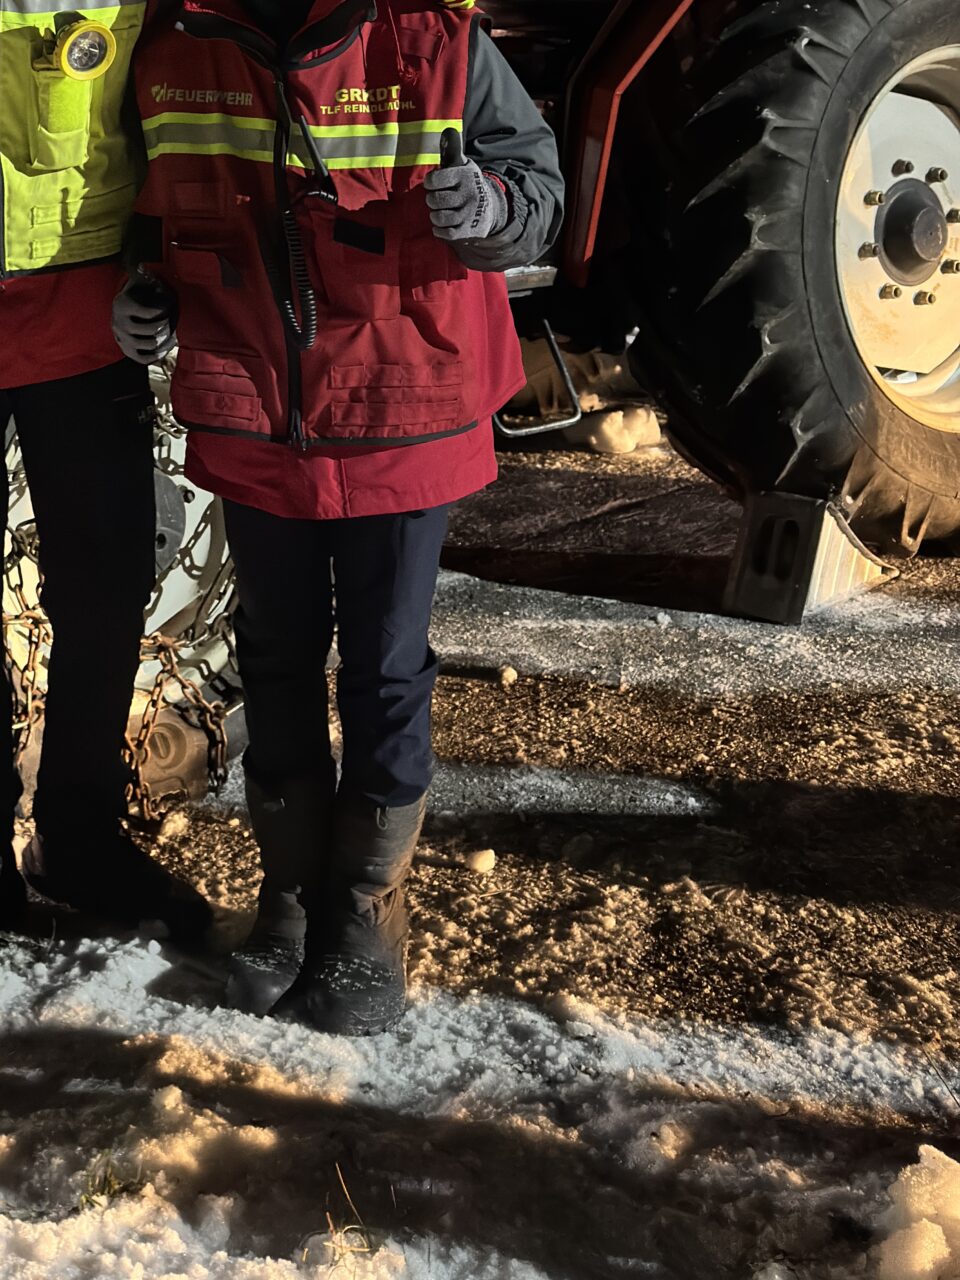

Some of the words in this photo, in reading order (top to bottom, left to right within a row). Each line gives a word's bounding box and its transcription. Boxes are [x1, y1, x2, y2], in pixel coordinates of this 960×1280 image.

[166, 88, 253, 107] FEUERWEHR
[335, 84, 401, 102] GRKDT
[320, 105, 341, 115] TLF
